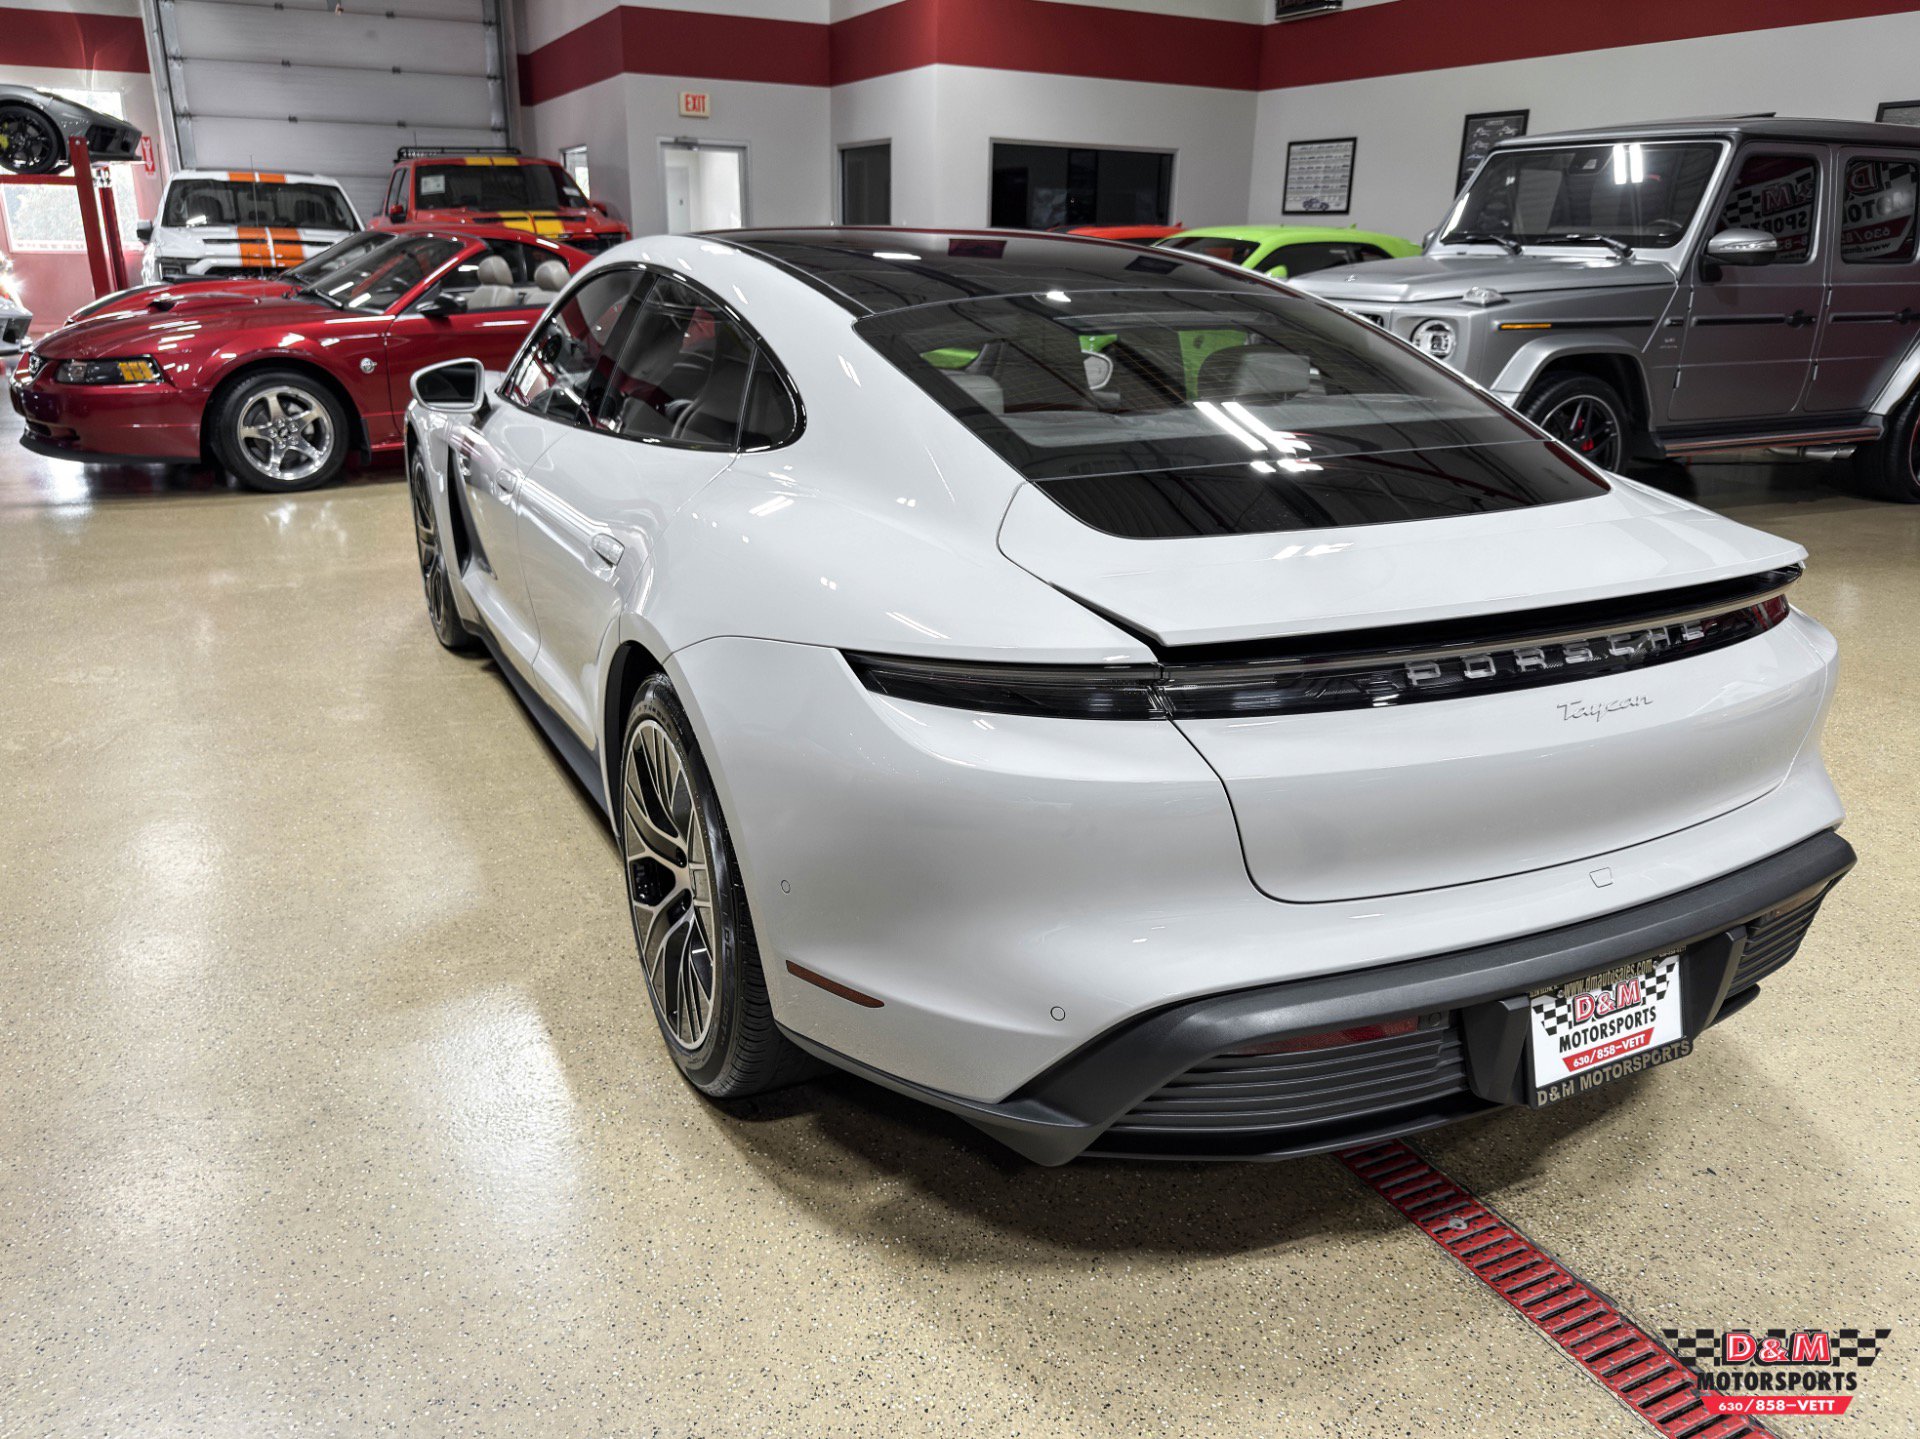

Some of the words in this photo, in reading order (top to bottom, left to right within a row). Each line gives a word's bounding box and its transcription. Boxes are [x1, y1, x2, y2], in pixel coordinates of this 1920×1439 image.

[685, 94, 706, 113] EXIT
[1405, 623, 1704, 686] PORSCHE
[1556, 695, 1653, 722] Taycan
[1573, 978, 1643, 1026] D&M
[1559, 1005, 1657, 1054] MOTORSPORTS
[1573, 1033, 1646, 1068] 630/858-VETT
[1537, 1081, 1575, 1107] D&M
[1580, 1040, 1691, 1092] MOTORSPORTS
